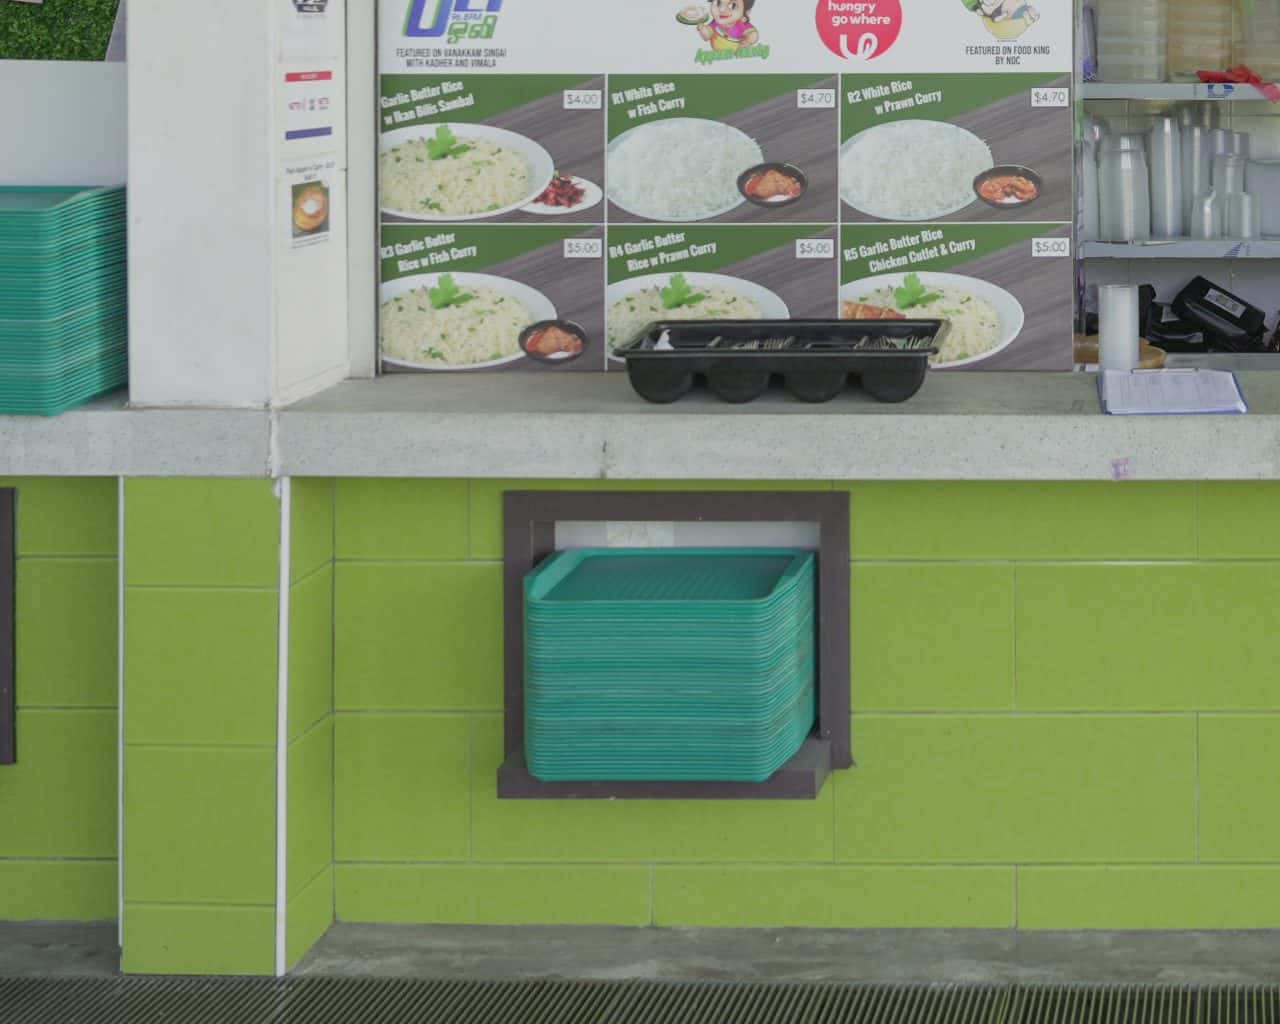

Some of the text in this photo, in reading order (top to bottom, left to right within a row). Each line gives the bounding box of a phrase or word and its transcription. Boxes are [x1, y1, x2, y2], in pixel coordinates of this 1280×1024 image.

[828, 0, 876, 13] hungry
[966, 46, 1050, 55] FEATURED ON FOOD KING
[995, 56, 1004, 65] BY
[612, 81, 675, 105] R1 White Rice
[801, 93, 832, 104] $4.70
[628, 97, 685, 118] w Fish Curry
[844, 229, 944, 262] R5 Garlic Butter Rice
[1034, 242, 1067, 253] $5.00
[868, 238, 976, 273] Chicken Cutlet & Curry
